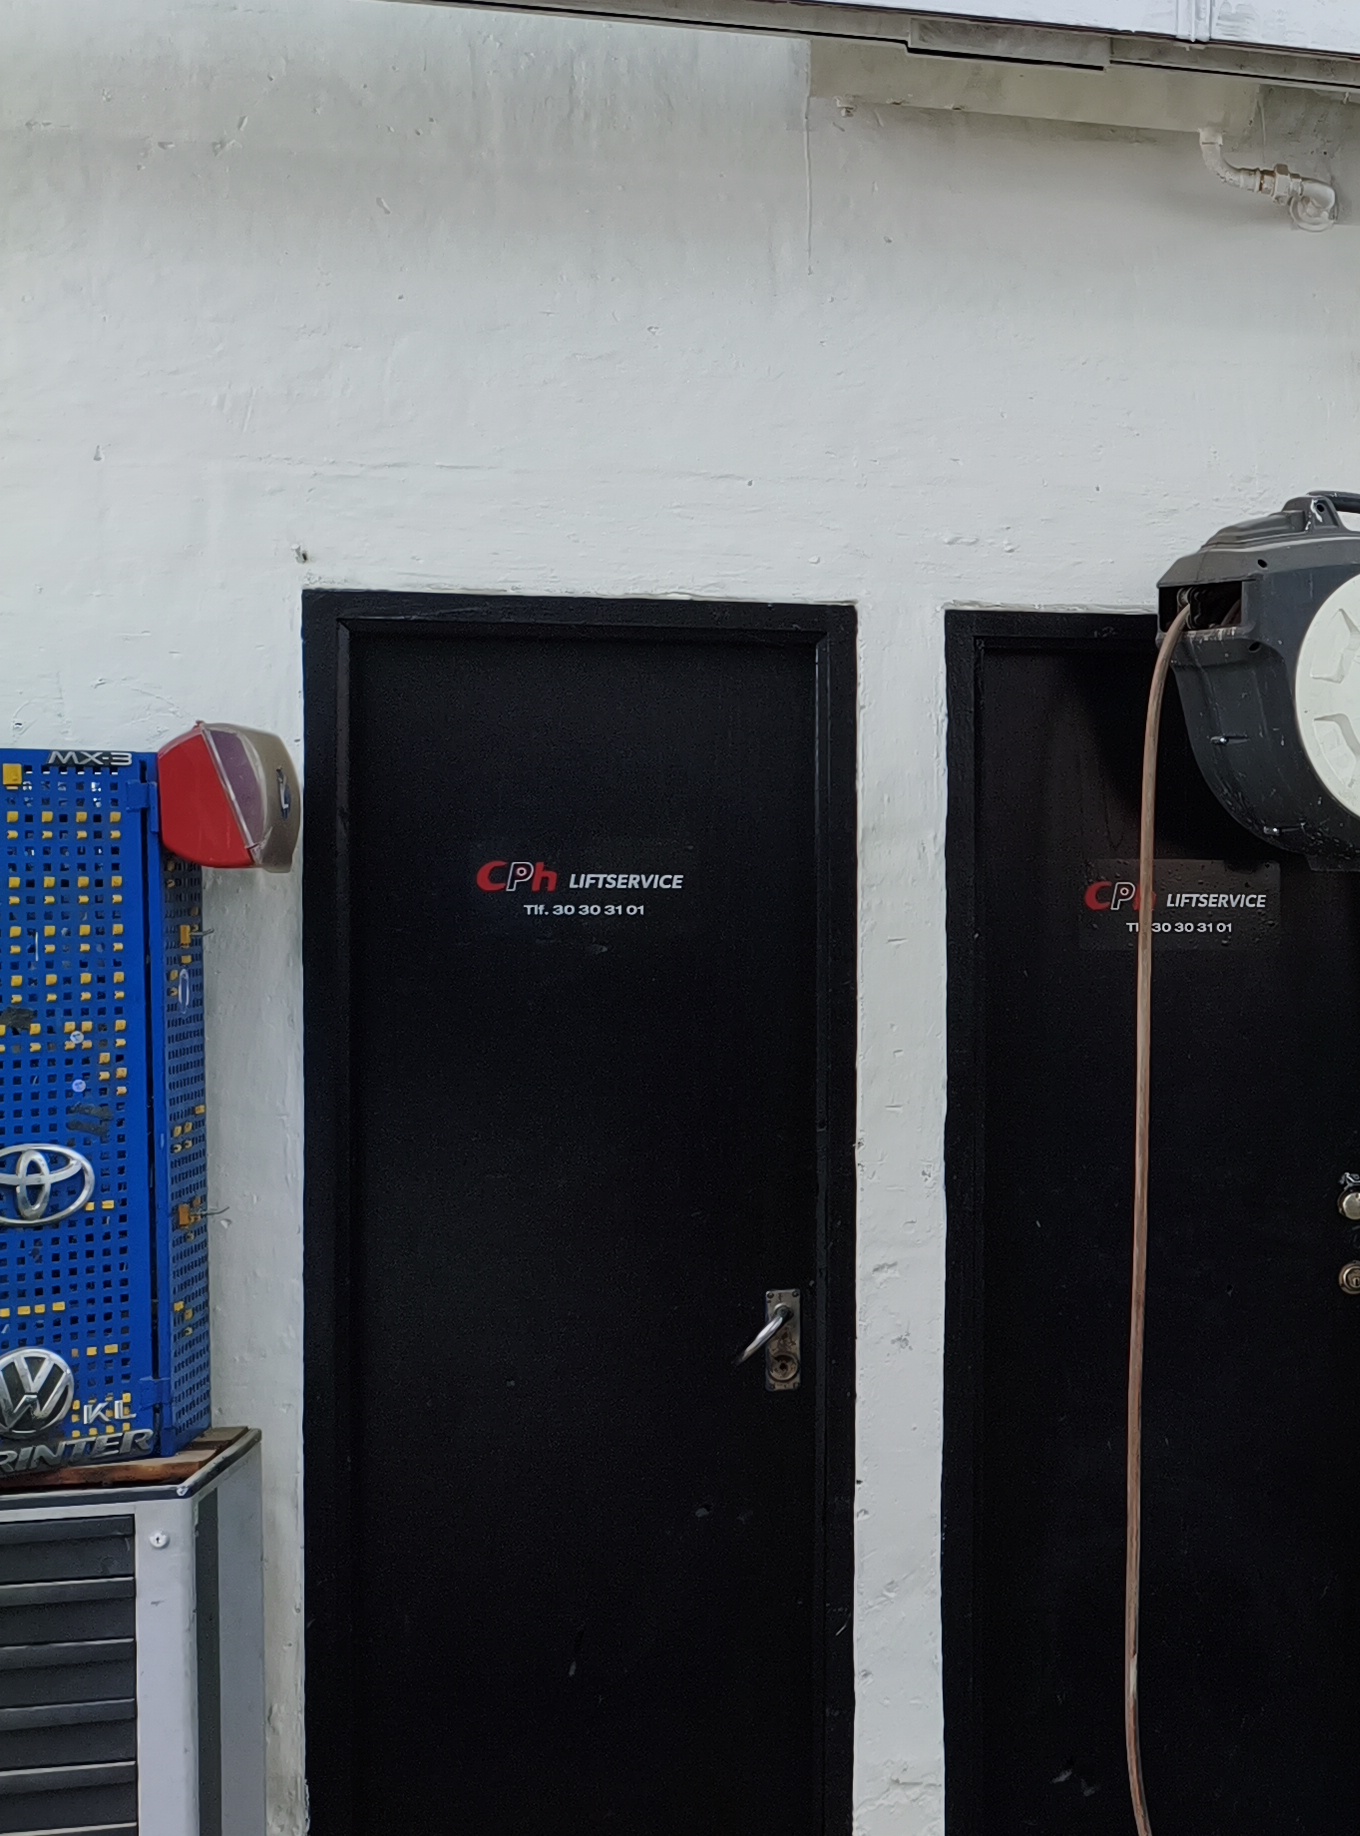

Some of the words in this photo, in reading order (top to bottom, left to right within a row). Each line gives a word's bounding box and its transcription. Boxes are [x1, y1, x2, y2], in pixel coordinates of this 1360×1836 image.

[48, 750, 133, 766] MX-3
[568, 873, 684, 889] LIFTSERVICE
[1166, 893, 1267, 908] LIFTSERVICE
[523, 904, 549, 916] Tlf.
[552, 904, 575, 916] 30
[578, 904, 601, 916] 30
[604, 904, 623, 916] 31
[626, 904, 645, 916] 01
[1151, 922, 1172, 933] 30
[1174, 922, 1194, 933] 30
[1196, 922, 1213, 933] 31
[1216, 922, 1232, 933] 01
